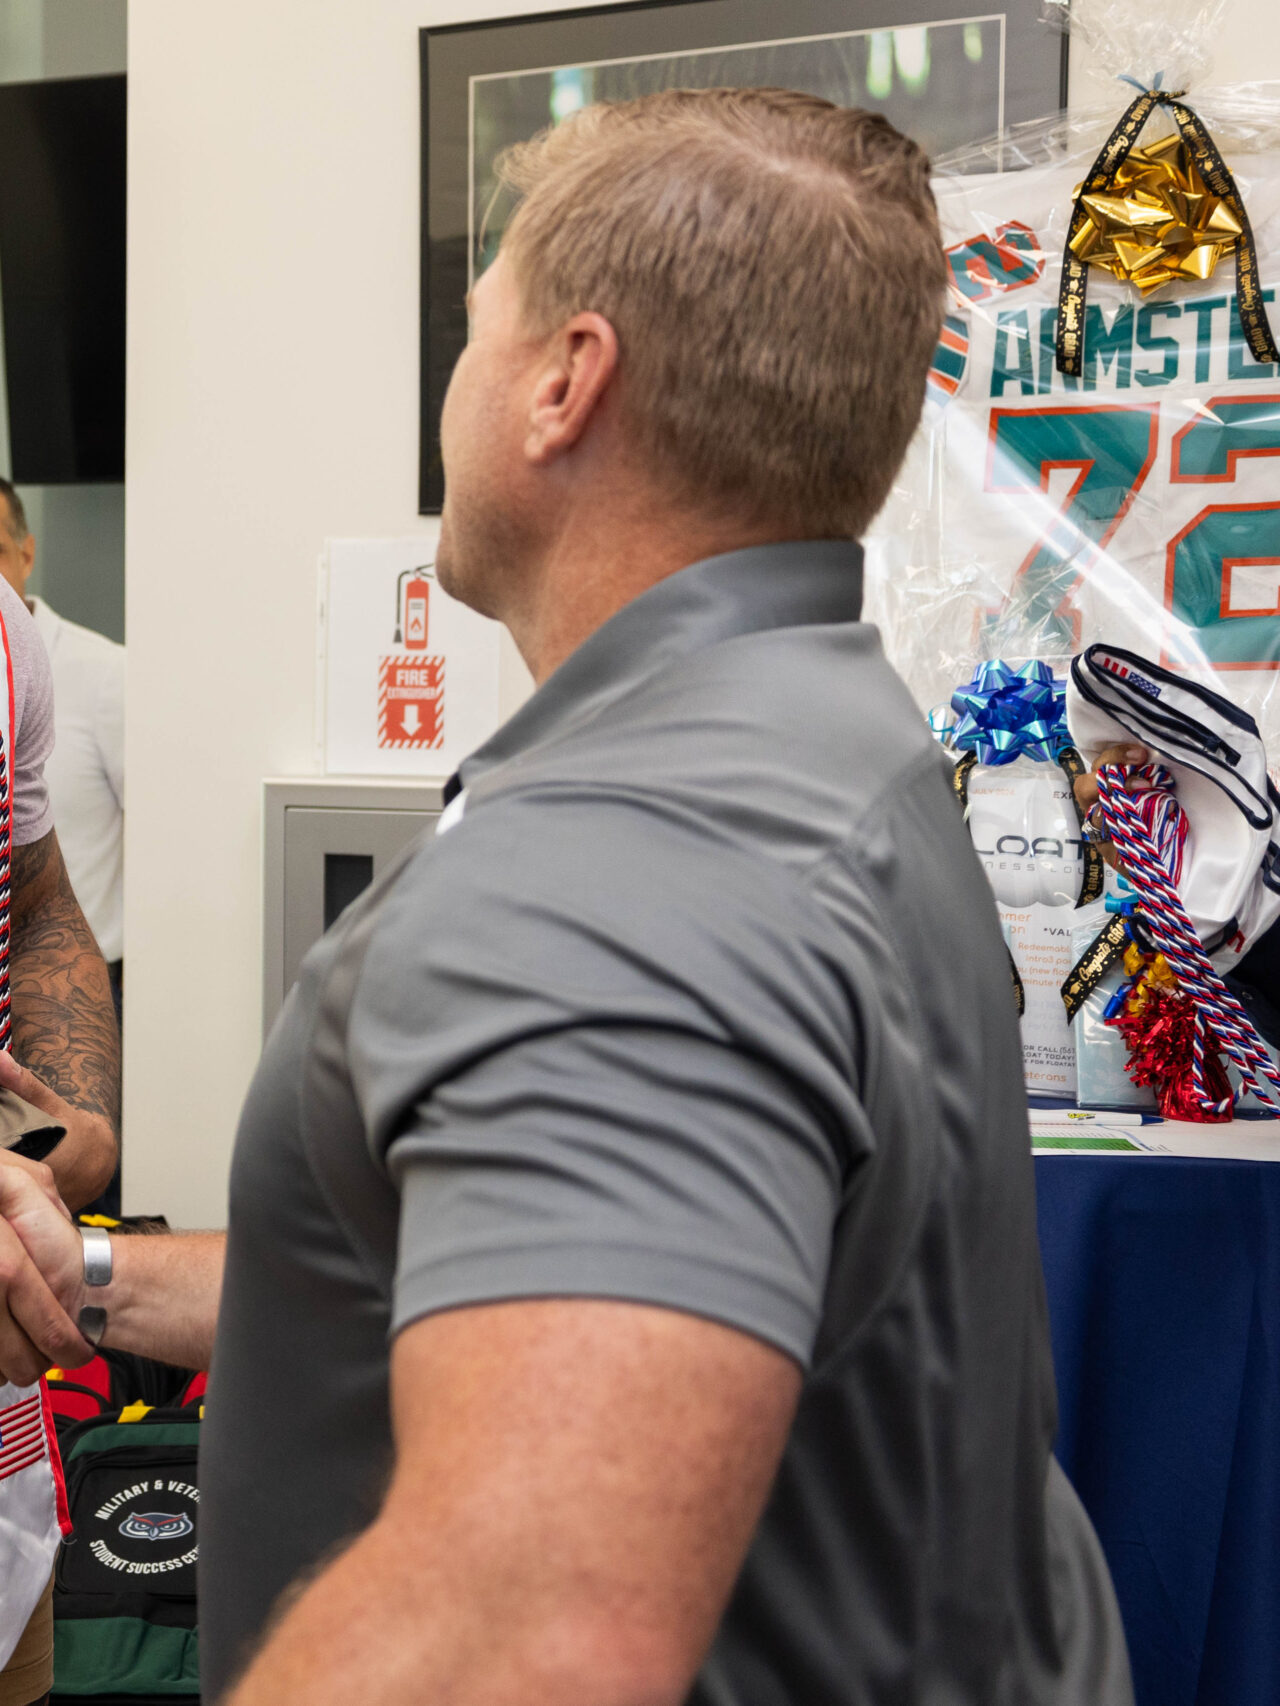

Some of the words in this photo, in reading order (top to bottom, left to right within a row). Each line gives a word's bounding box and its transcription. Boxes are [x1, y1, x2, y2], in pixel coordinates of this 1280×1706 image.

[990, 289, 1280, 398] ARMSTE
[396, 669, 429, 686] FIRE
[1087, 864, 1099, 891] GRAD
[1107, 917, 1128, 945] GRA
[94, 1481, 149, 1520] MILITARY
[154, 1479, 164, 1490] &
[89, 1539, 129, 1571] STUDENT
[126, 1558, 183, 1574] SUCCESS
